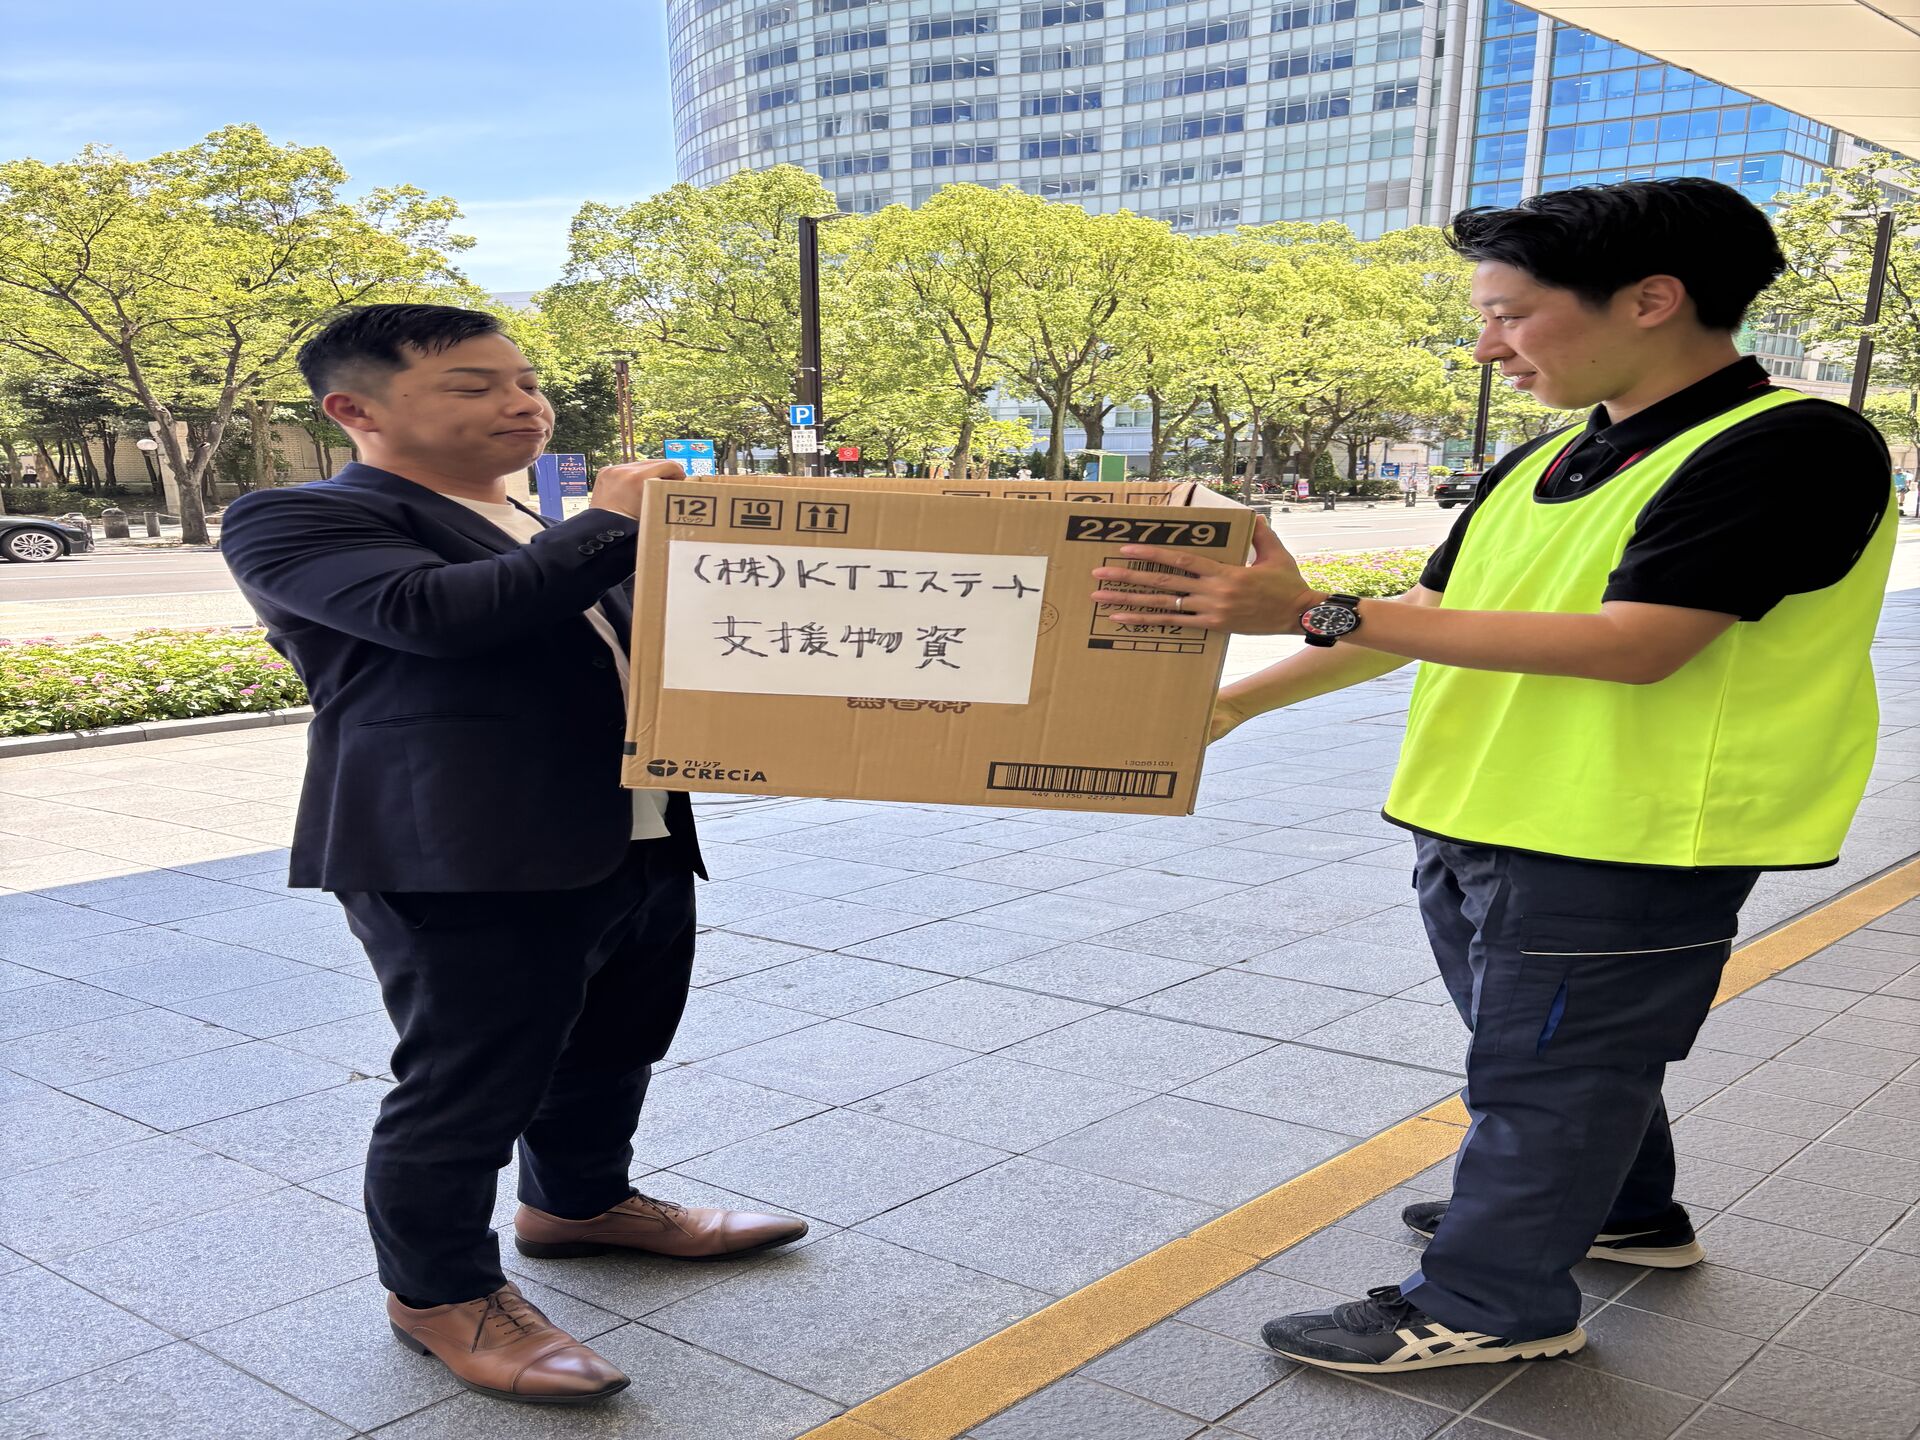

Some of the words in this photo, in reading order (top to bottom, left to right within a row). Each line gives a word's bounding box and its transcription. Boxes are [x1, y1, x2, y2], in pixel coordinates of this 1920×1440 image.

[796, 408, 810, 423] P
[673, 499, 707, 516] 12
[743, 502, 770, 515] 10
[676, 516, 704, 524] パック
[1077, 519, 1216, 545] 22779
[712, 616, 966, 669] 支援物資
